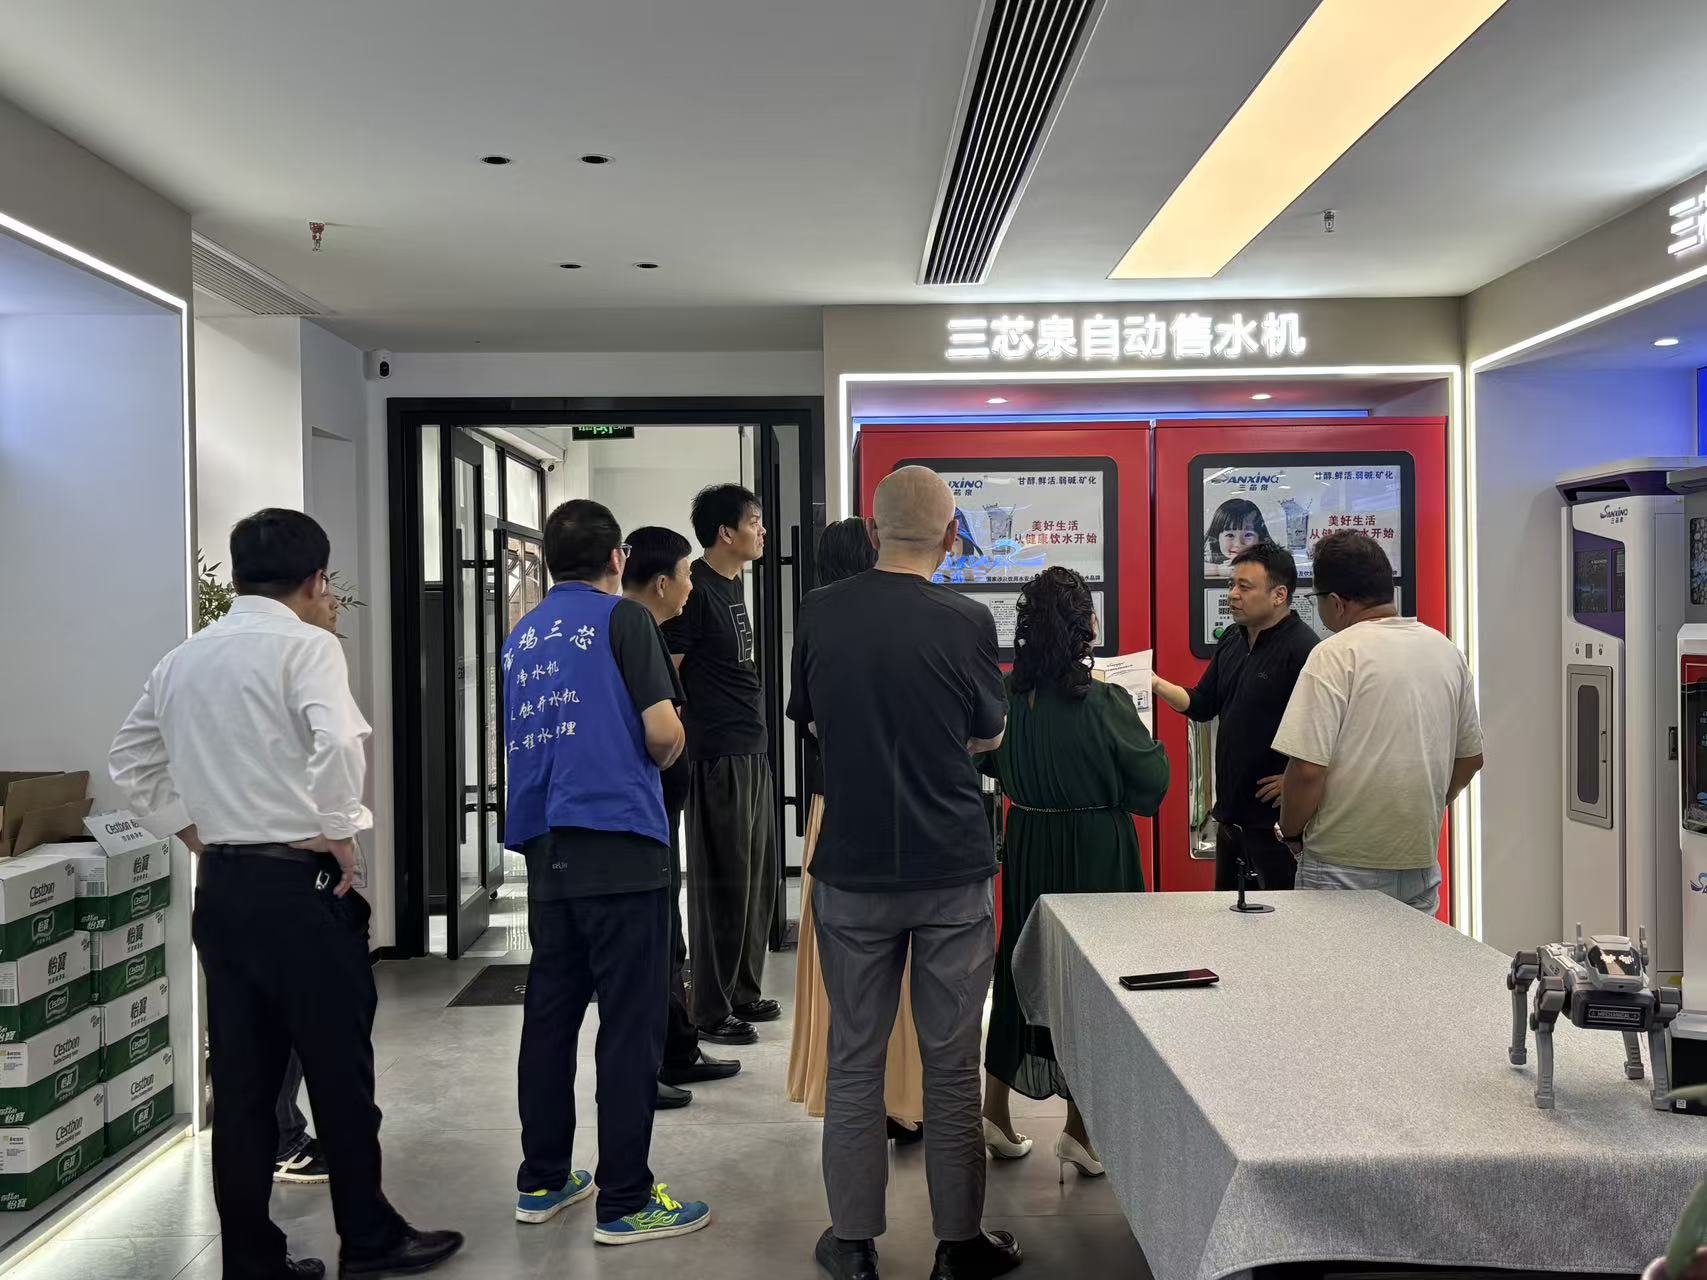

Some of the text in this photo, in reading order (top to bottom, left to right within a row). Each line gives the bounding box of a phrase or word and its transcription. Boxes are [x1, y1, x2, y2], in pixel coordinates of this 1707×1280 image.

[945, 311, 1307, 361] 三芯泉自动售水机
[1032, 520, 1078, 531] 美好生活
[1328, 514, 1376, 526] 美好生活
[1014, 533, 1097, 544] 从健康饮水开始
